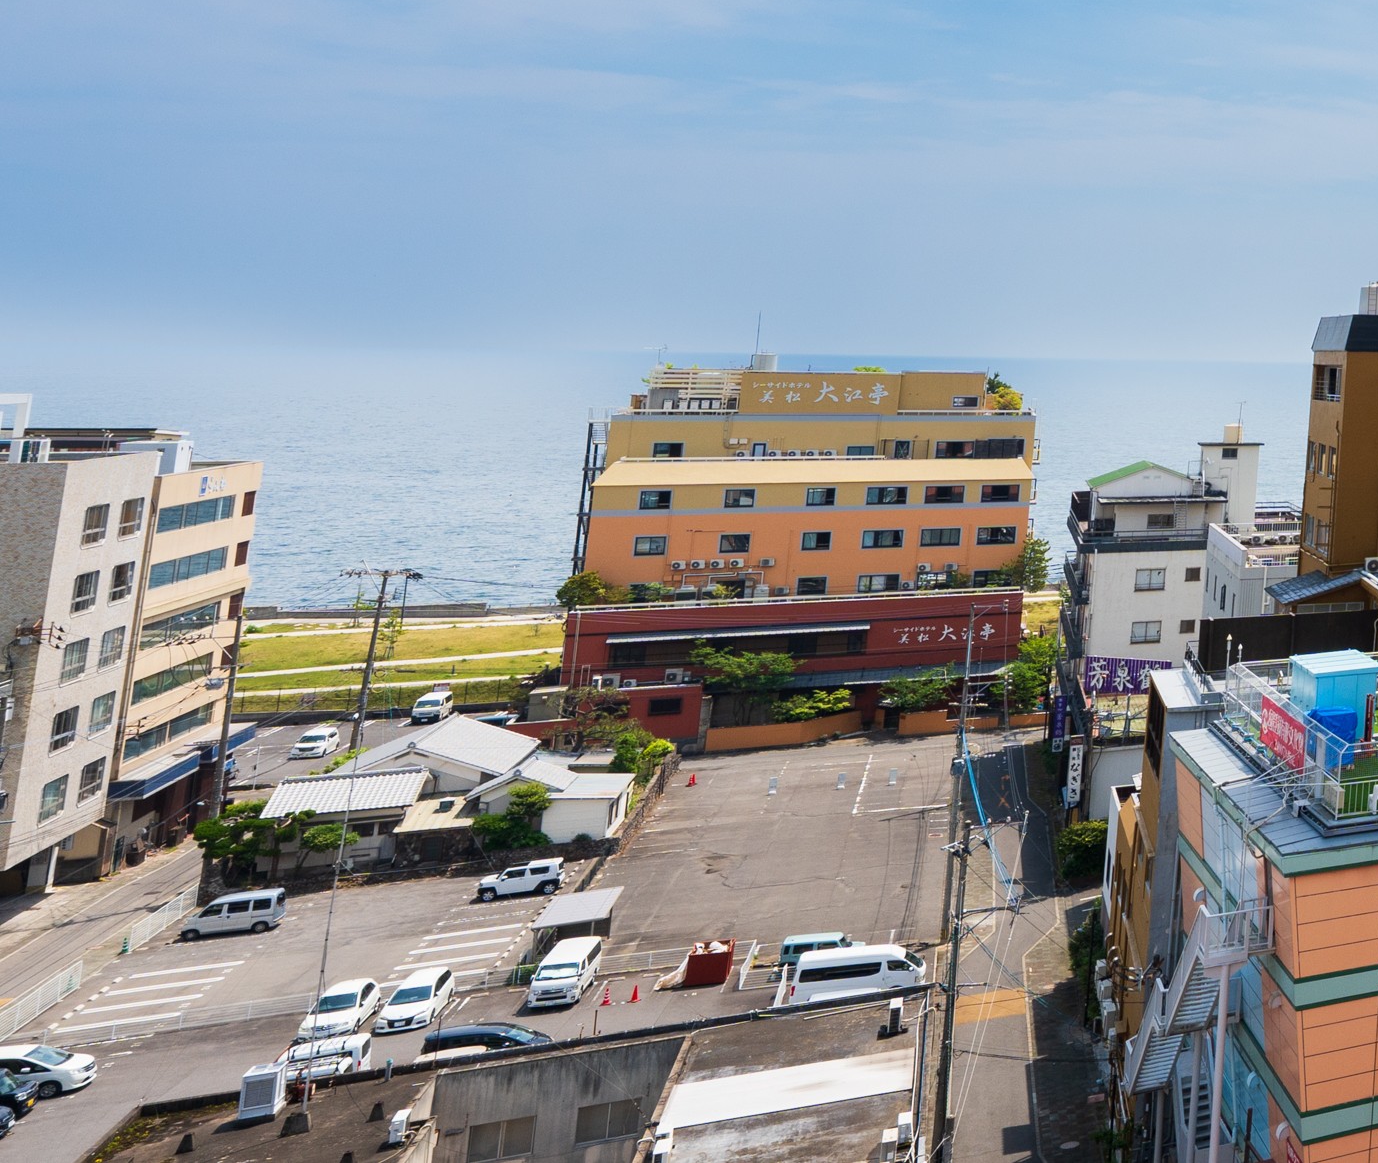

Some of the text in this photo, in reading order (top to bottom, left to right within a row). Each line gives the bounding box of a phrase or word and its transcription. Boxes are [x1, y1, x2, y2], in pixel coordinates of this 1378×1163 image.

[752, 381, 812, 389] シーサイドホテル
[759, 381, 889, 405] 美松 大江亭
[898, 632, 930, 644] 美松
[1069, 763, 1081, 799] なぎさ
